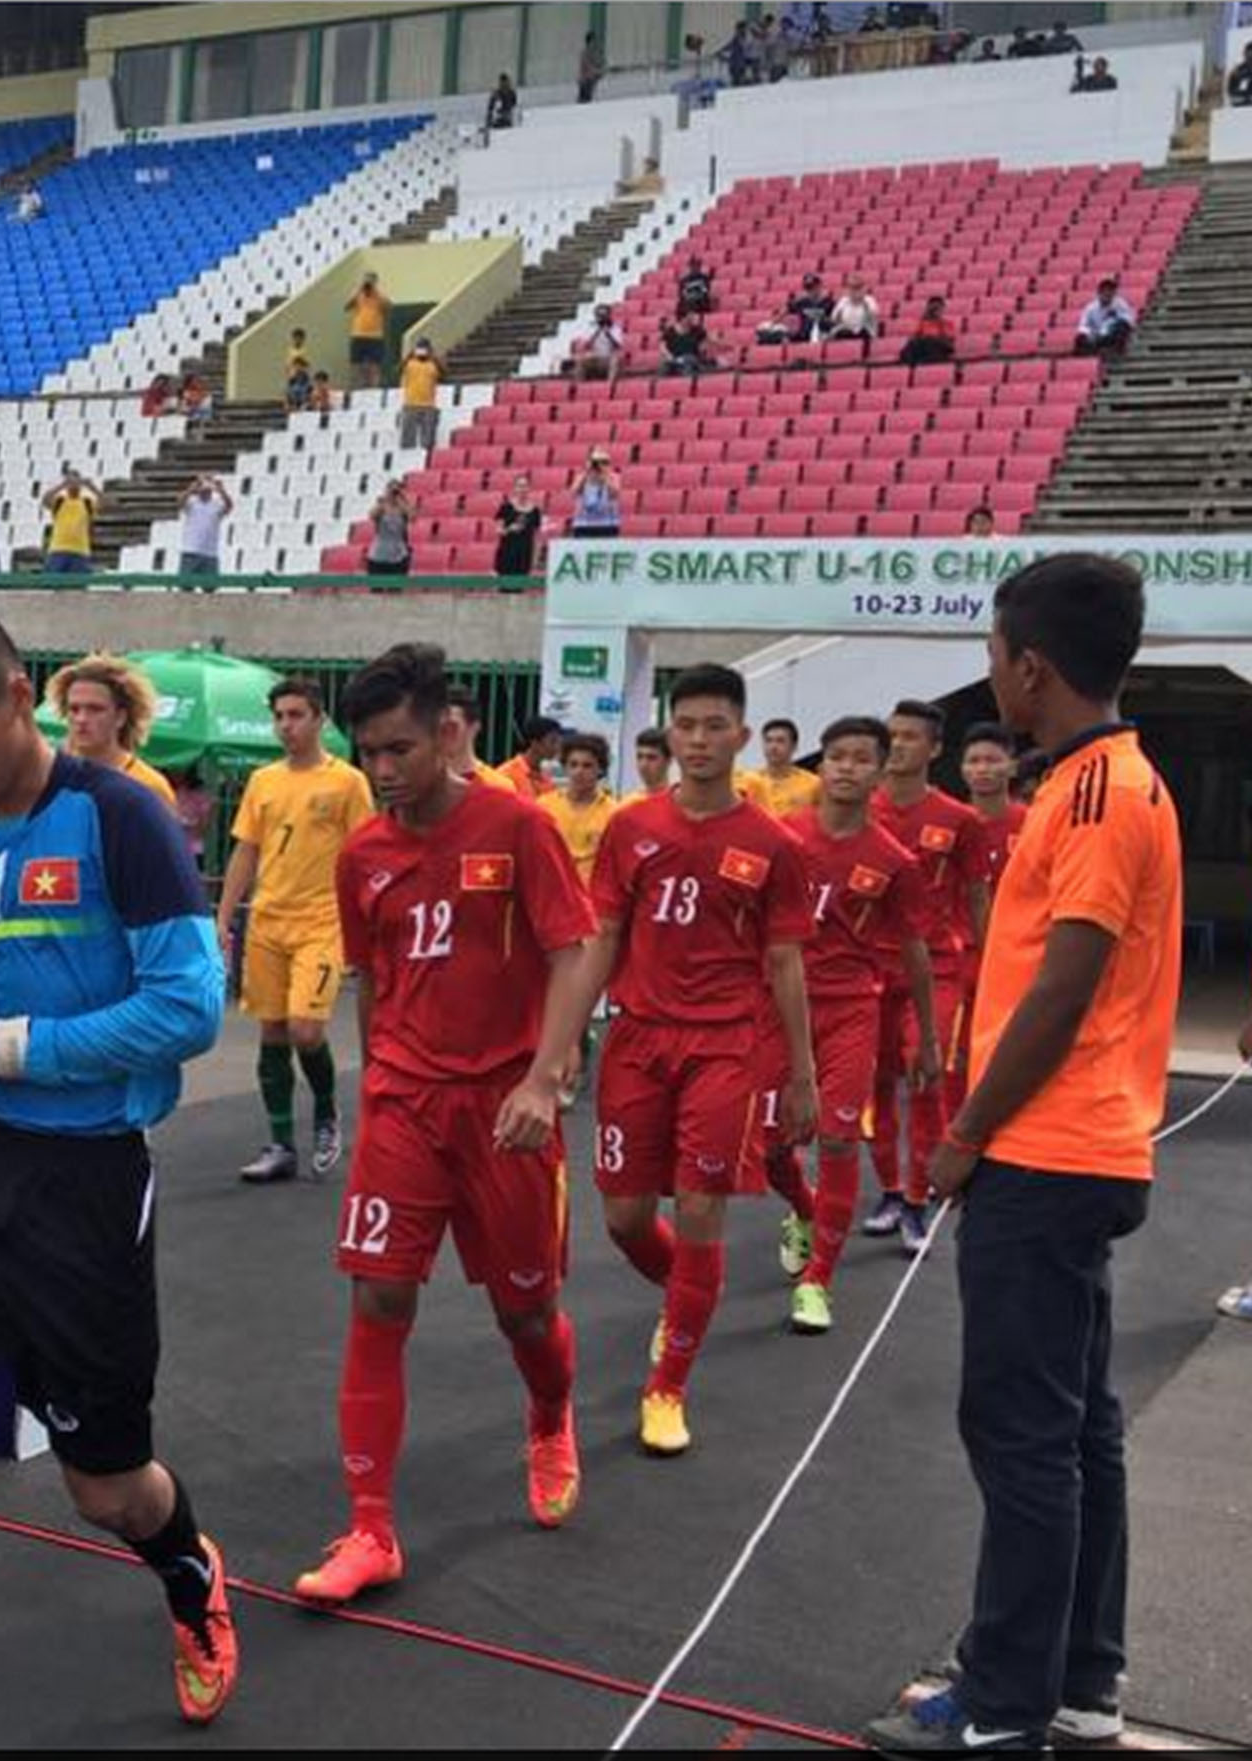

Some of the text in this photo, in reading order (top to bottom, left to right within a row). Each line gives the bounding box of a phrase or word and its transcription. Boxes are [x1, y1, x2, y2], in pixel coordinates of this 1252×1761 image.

[553, 551, 634, 583] AFF
[647, 550, 800, 583] SMART
[816, 549, 915, 583] U-16
[852, 594, 985, 620] 10-23 July
[278, 824, 293, 855] 7
[653, 876, 700, 925] 13
[408, 900, 453, 960] 12
[317, 964, 330, 994] 7
[339, 1194, 390, 1253] 12
